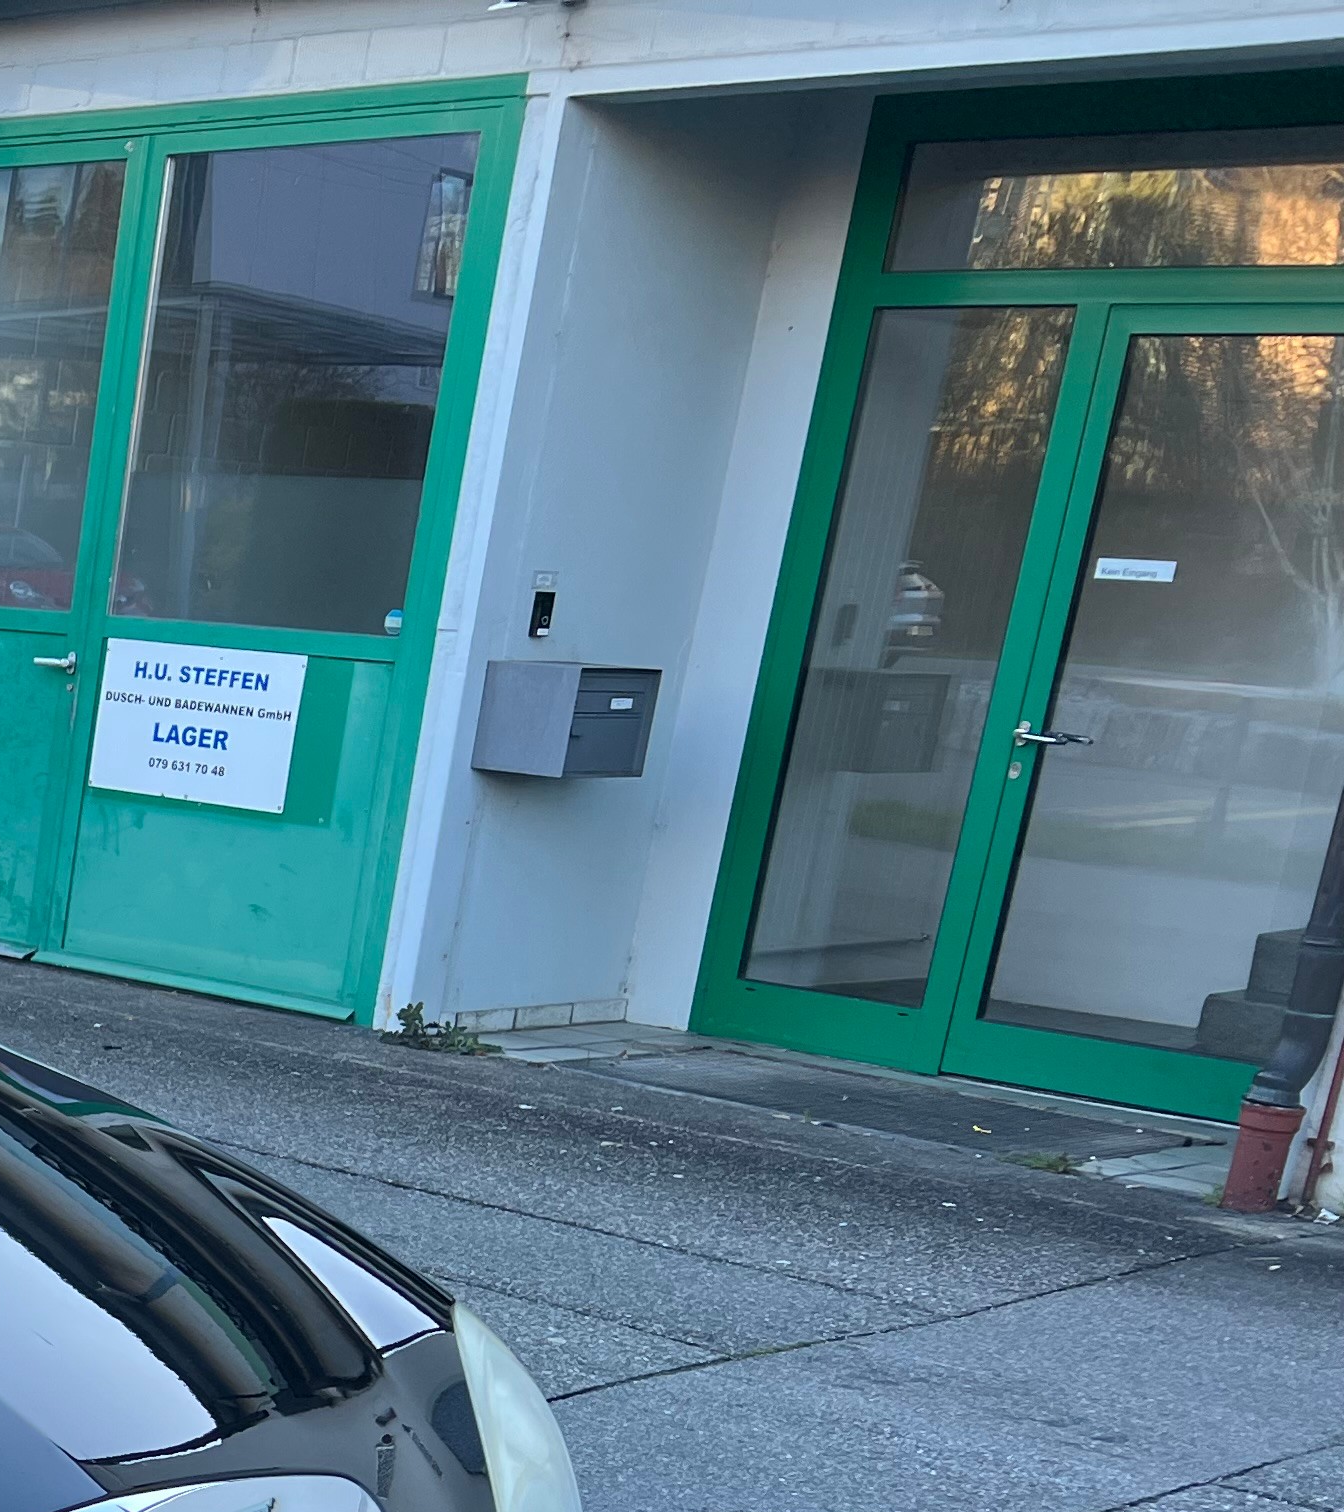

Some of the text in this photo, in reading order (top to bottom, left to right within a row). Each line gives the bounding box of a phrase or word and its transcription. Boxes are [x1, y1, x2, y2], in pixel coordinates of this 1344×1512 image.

[134, 661, 270, 692] H.U. STEFFEN
[105, 690, 293, 722] DUSCH- UND BADEWANNEN GmbH
[152, 722, 229, 751] LAGER
[148, 757, 226, 777] 079 631 70 48
